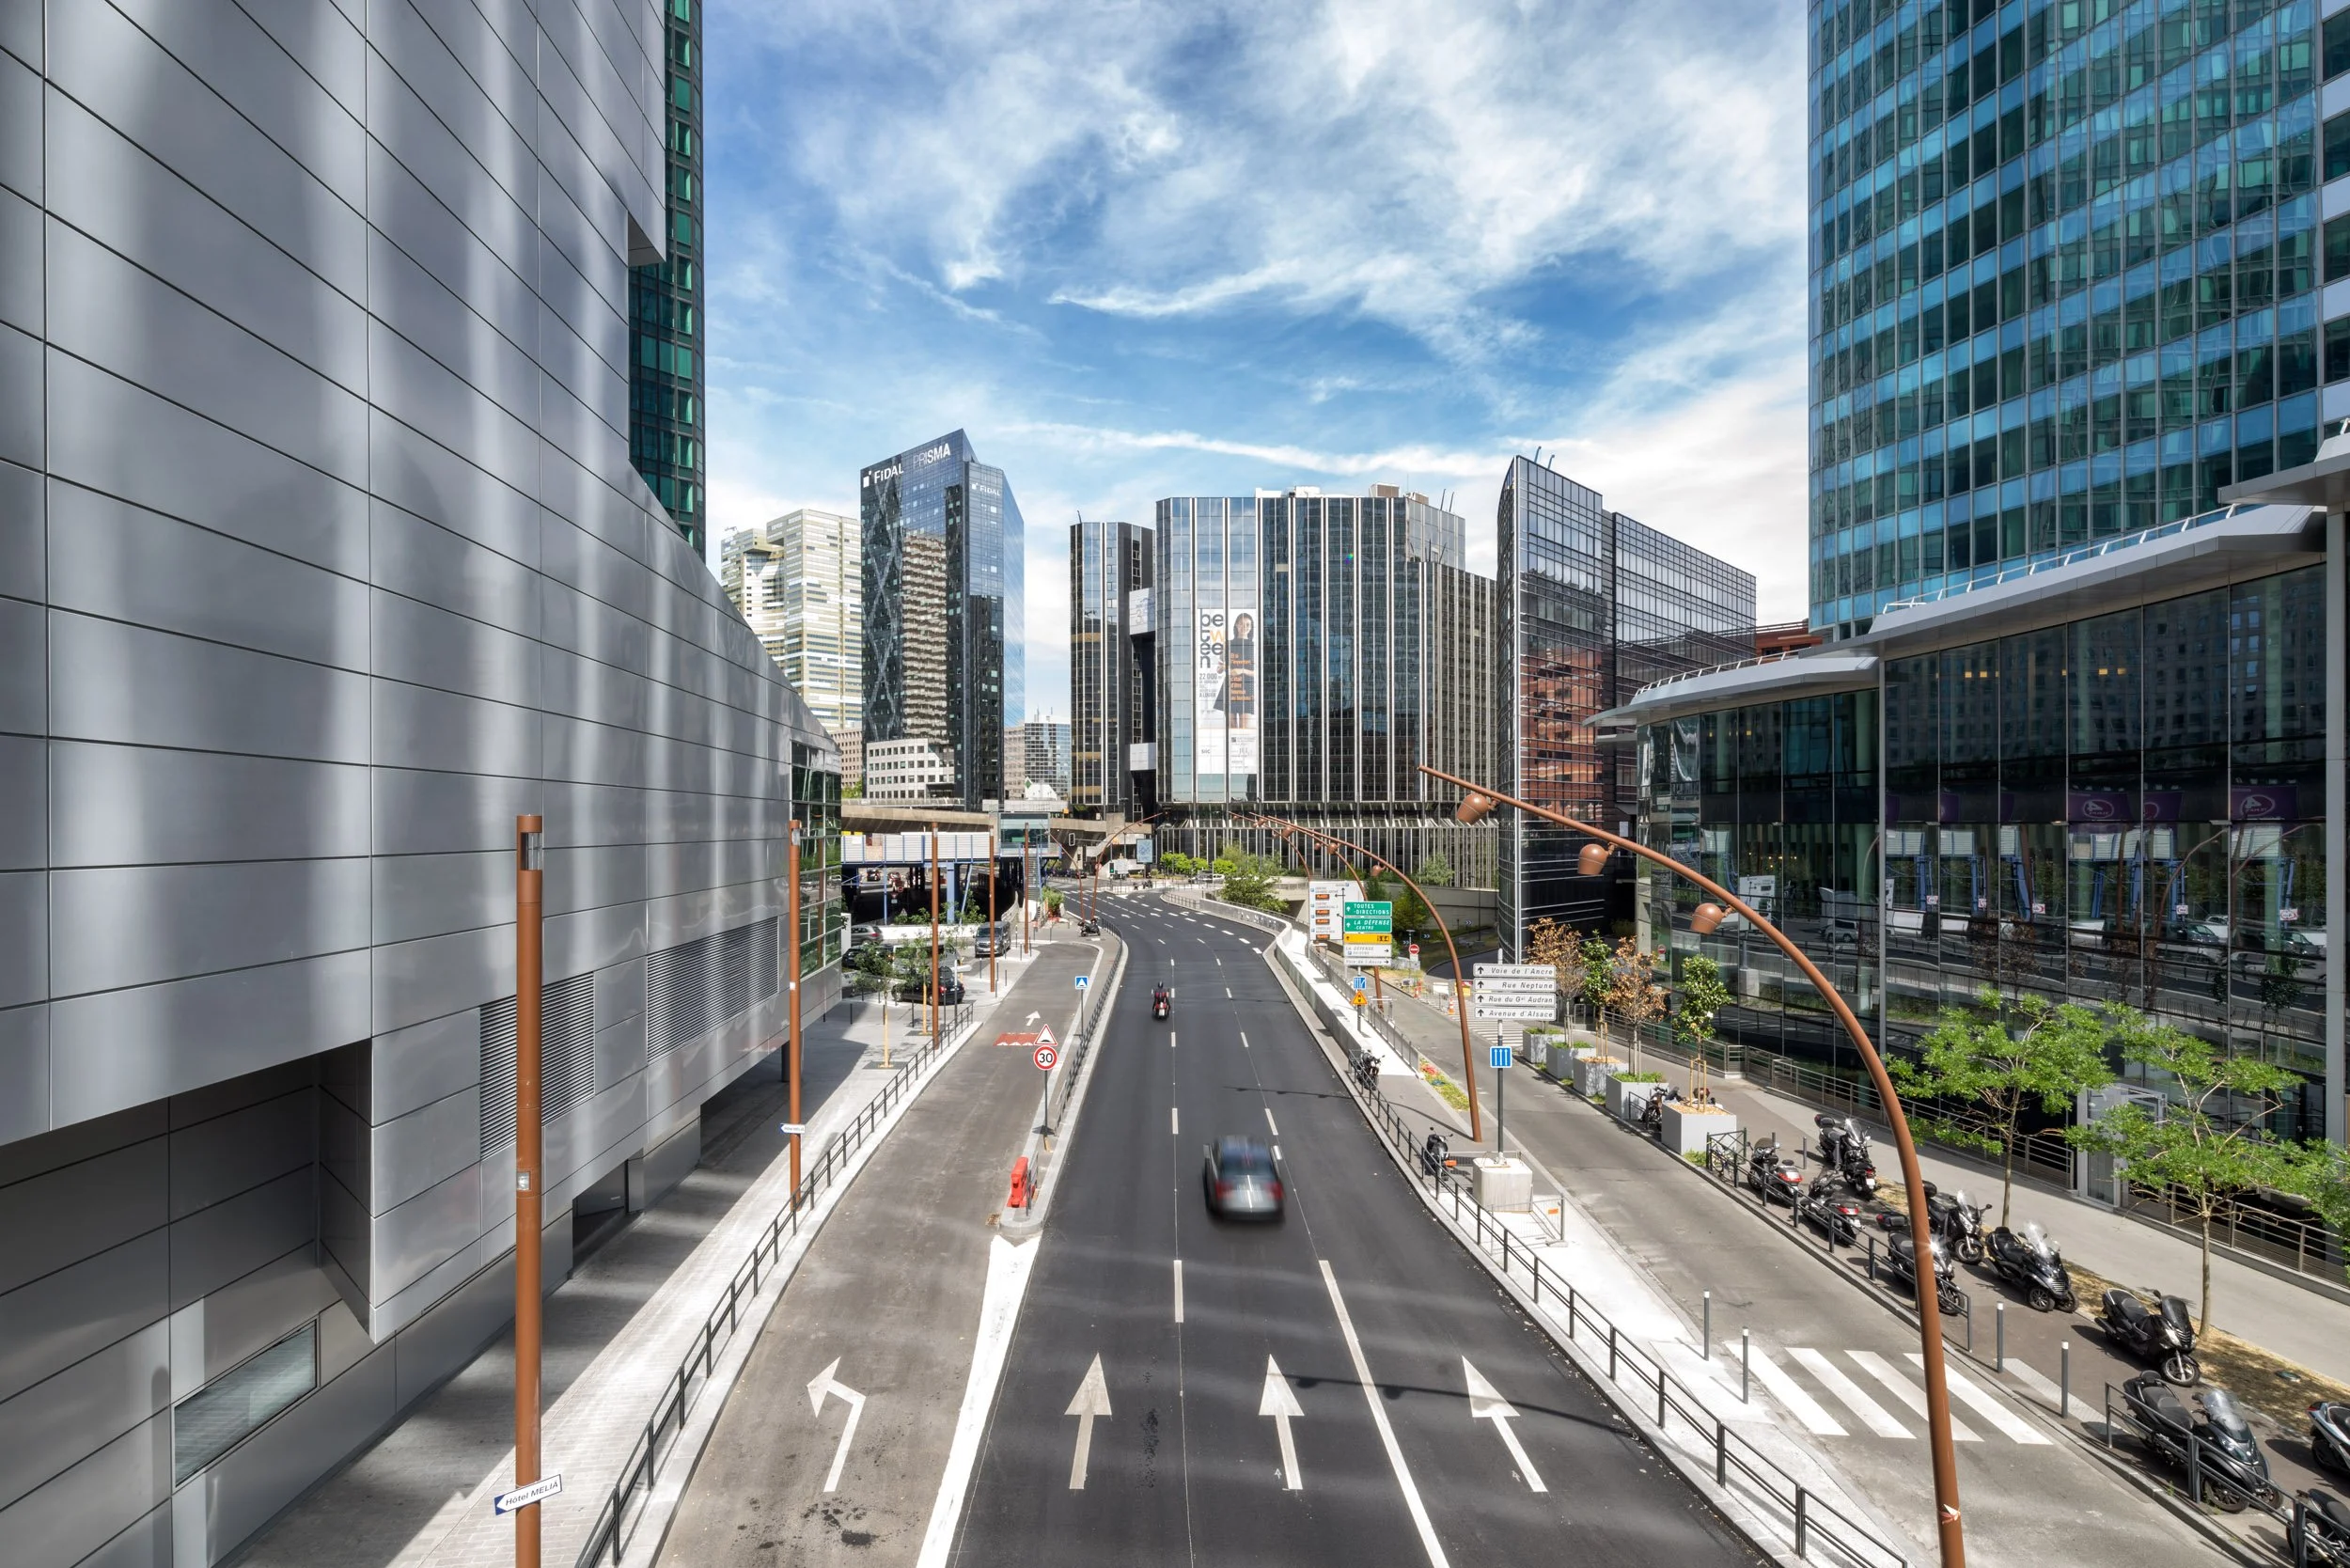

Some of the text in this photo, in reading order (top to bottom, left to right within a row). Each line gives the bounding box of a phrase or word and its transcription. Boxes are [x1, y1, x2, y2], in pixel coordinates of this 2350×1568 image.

[913, 443, 951, 468] PRISMA
[1039, 1053, 1054, 1063] 30
[506, 1493, 529, 1506] Hôtel
